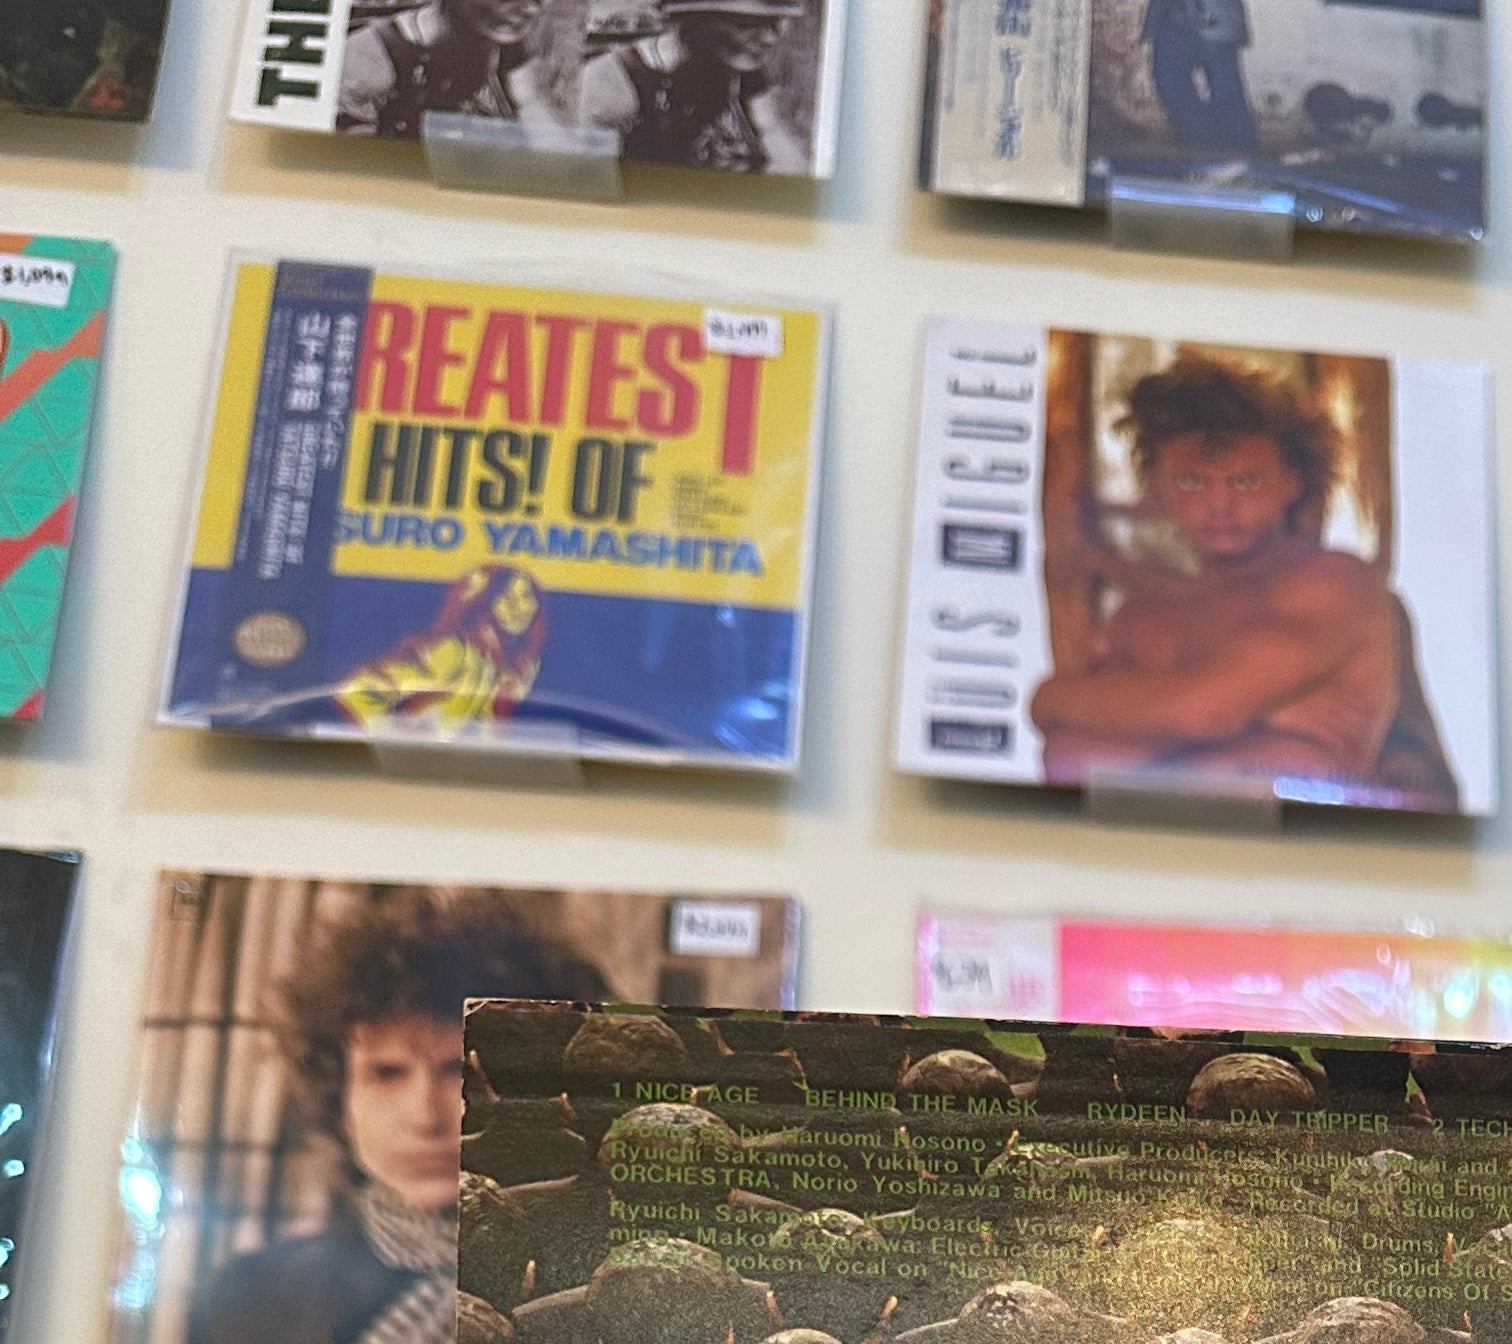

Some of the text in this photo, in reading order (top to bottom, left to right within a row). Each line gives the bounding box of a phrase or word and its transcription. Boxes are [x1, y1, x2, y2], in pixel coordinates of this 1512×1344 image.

[363, 419, 552, 518] HITS!
[570, 434, 657, 525] OF
[482, 519, 765, 575] YAMASHITA
[613, 1083, 623, 1100] 1
[635, 1082, 694, 1102] NICE
[710, 1085, 760, 1105] AGE
[805, 1089, 897, 1110] BEHIND
[909, 1094, 957, 1114] THE
[967, 1097, 1039, 1118] MASK
[1086, 1102, 1187, 1124] RYDEEN
[1230, 1108, 1280, 1128] DAY
[1292, 1110, 1390, 1133] TRIPPER
[1432, 1118, 1445, 1138] 2
[610, 1140, 702, 1167] Ryuichi
[714, 1146, 850, 1172] Sakamoto,
[861, 1150, 959, 1175] Yukihiro
[740, 1124, 769, 1145] by
[788, 1126, 882, 1148] Haruomi
[893, 1131, 987, 1153] Hosono
[1457, 1156, 1498, 1178] and
[609, 1162, 780, 1191] ORCHESTRA,
[791, 1169, 859, 1193] Norio
[871, 1174, 1000, 1199] Yoshizawa
[1013, 1182, 1057, 1202] and
[1067, 1183, 1146, 1206] Mitsuo
[1402, 1198, 1475, 1221] Studio
[609, 1199, 701, 1223] Ryuichi
[1361, 1231, 1441, 1259] Drums,
[609, 1225, 669, 1245] ming
[696, 1226, 794, 1249] Makoto
[815, 1251, 887, 1276] Vocal
[897, 1262, 929, 1279] on
